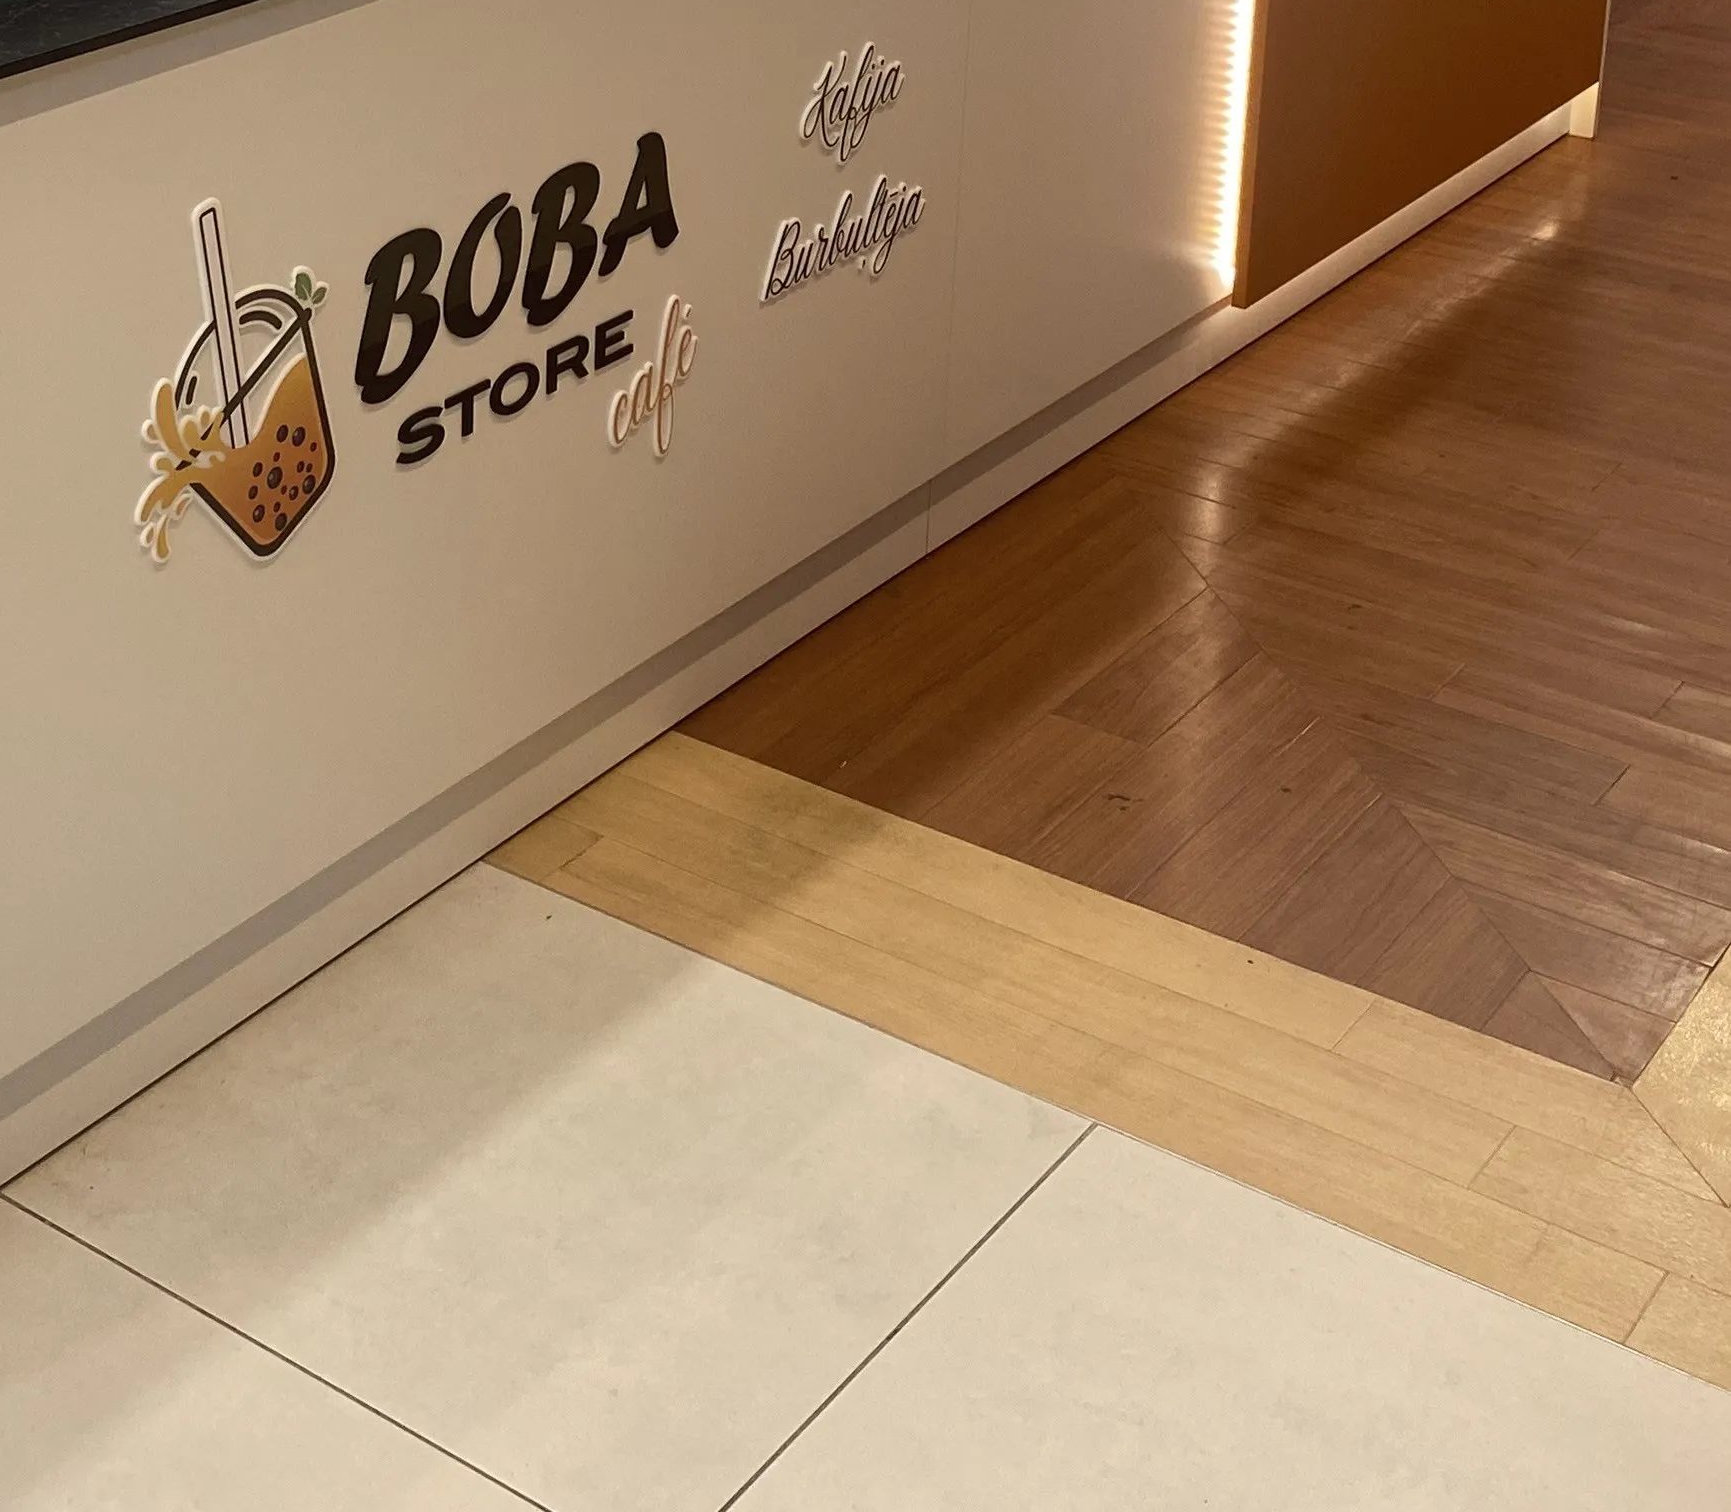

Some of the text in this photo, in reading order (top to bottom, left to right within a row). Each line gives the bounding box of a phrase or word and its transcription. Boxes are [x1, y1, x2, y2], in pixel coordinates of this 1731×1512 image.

[799, 41, 906, 166] Kafija
[353, 131, 679, 405] BOBA
[760, 174, 927, 301] Burbuļtēja
[396, 308, 634, 466] STORE
[606, 295, 698, 458] café
